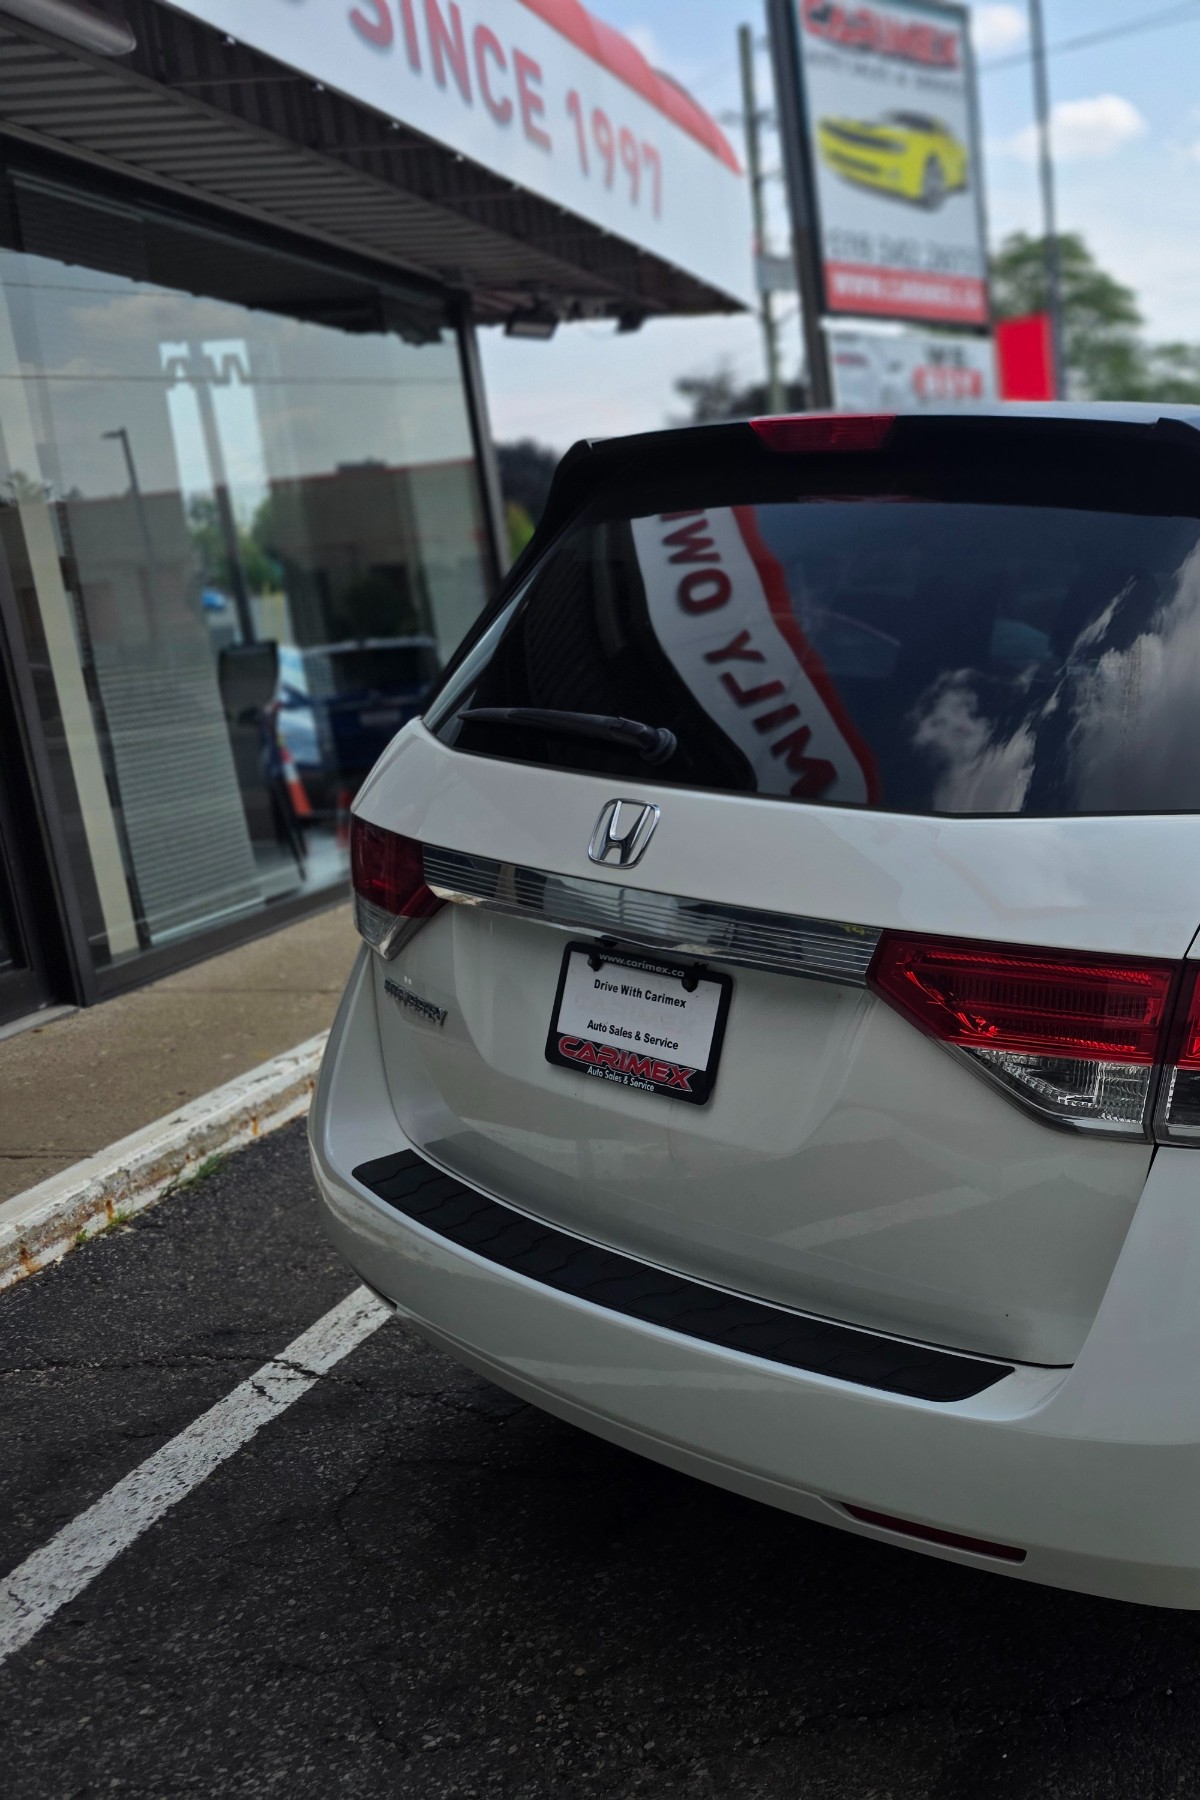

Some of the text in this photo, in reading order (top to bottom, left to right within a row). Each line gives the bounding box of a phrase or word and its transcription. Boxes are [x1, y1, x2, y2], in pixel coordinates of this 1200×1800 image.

[566, 89, 662, 220] 1997
[600, 953, 684, 977] www.carimex.ca
[594, 979, 687, 1008] Drive With Carimex
[587, 1020, 679, 1050] Auto Sales & Service
[559, 1036, 697, 1091] CARIMEX
[587, 1066, 655, 1092] Auto Sales & Service
